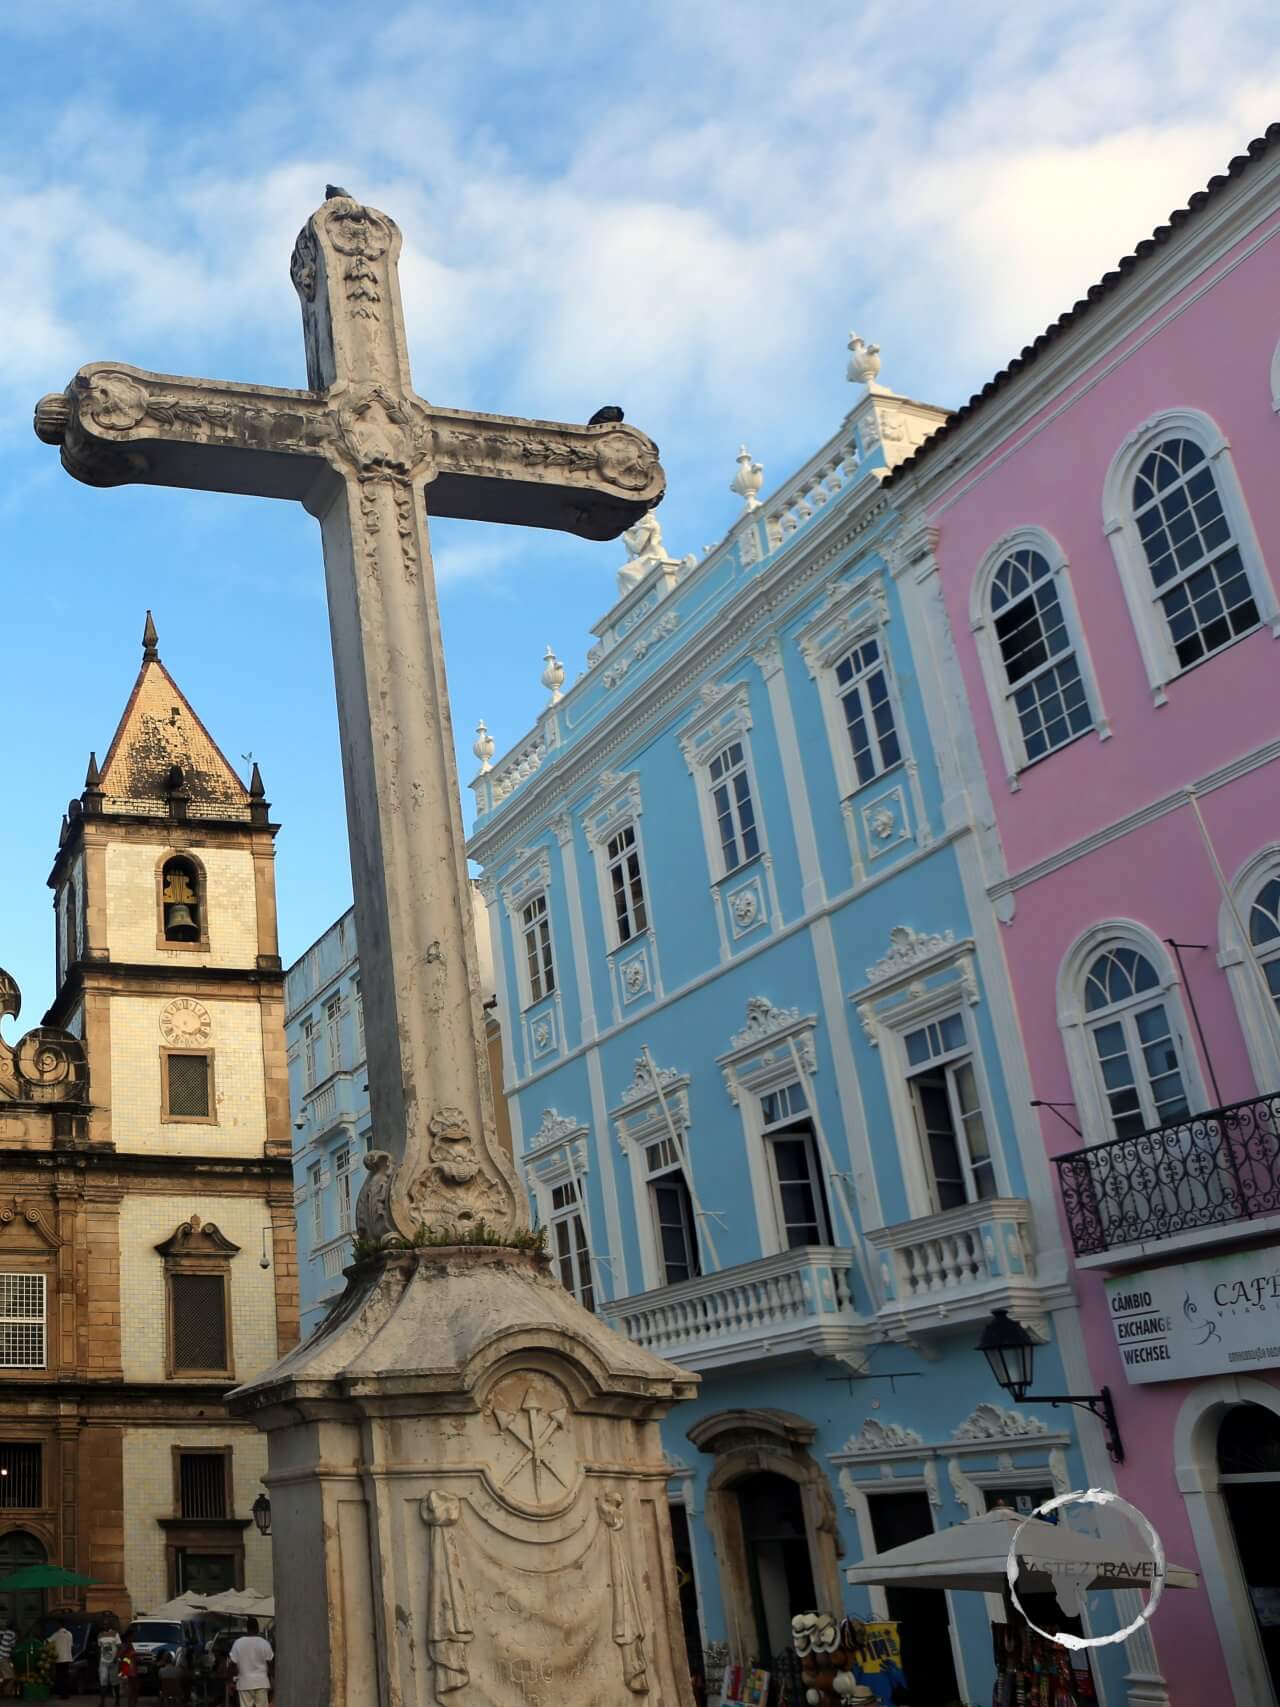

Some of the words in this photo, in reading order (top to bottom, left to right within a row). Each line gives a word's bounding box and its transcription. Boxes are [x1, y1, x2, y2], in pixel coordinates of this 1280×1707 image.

[1111, 1290, 1152, 1312] CÂMBIO
[1118, 1316, 1172, 1339] EXCHANGE
[1123, 1344, 1171, 1365] WECHSEL
